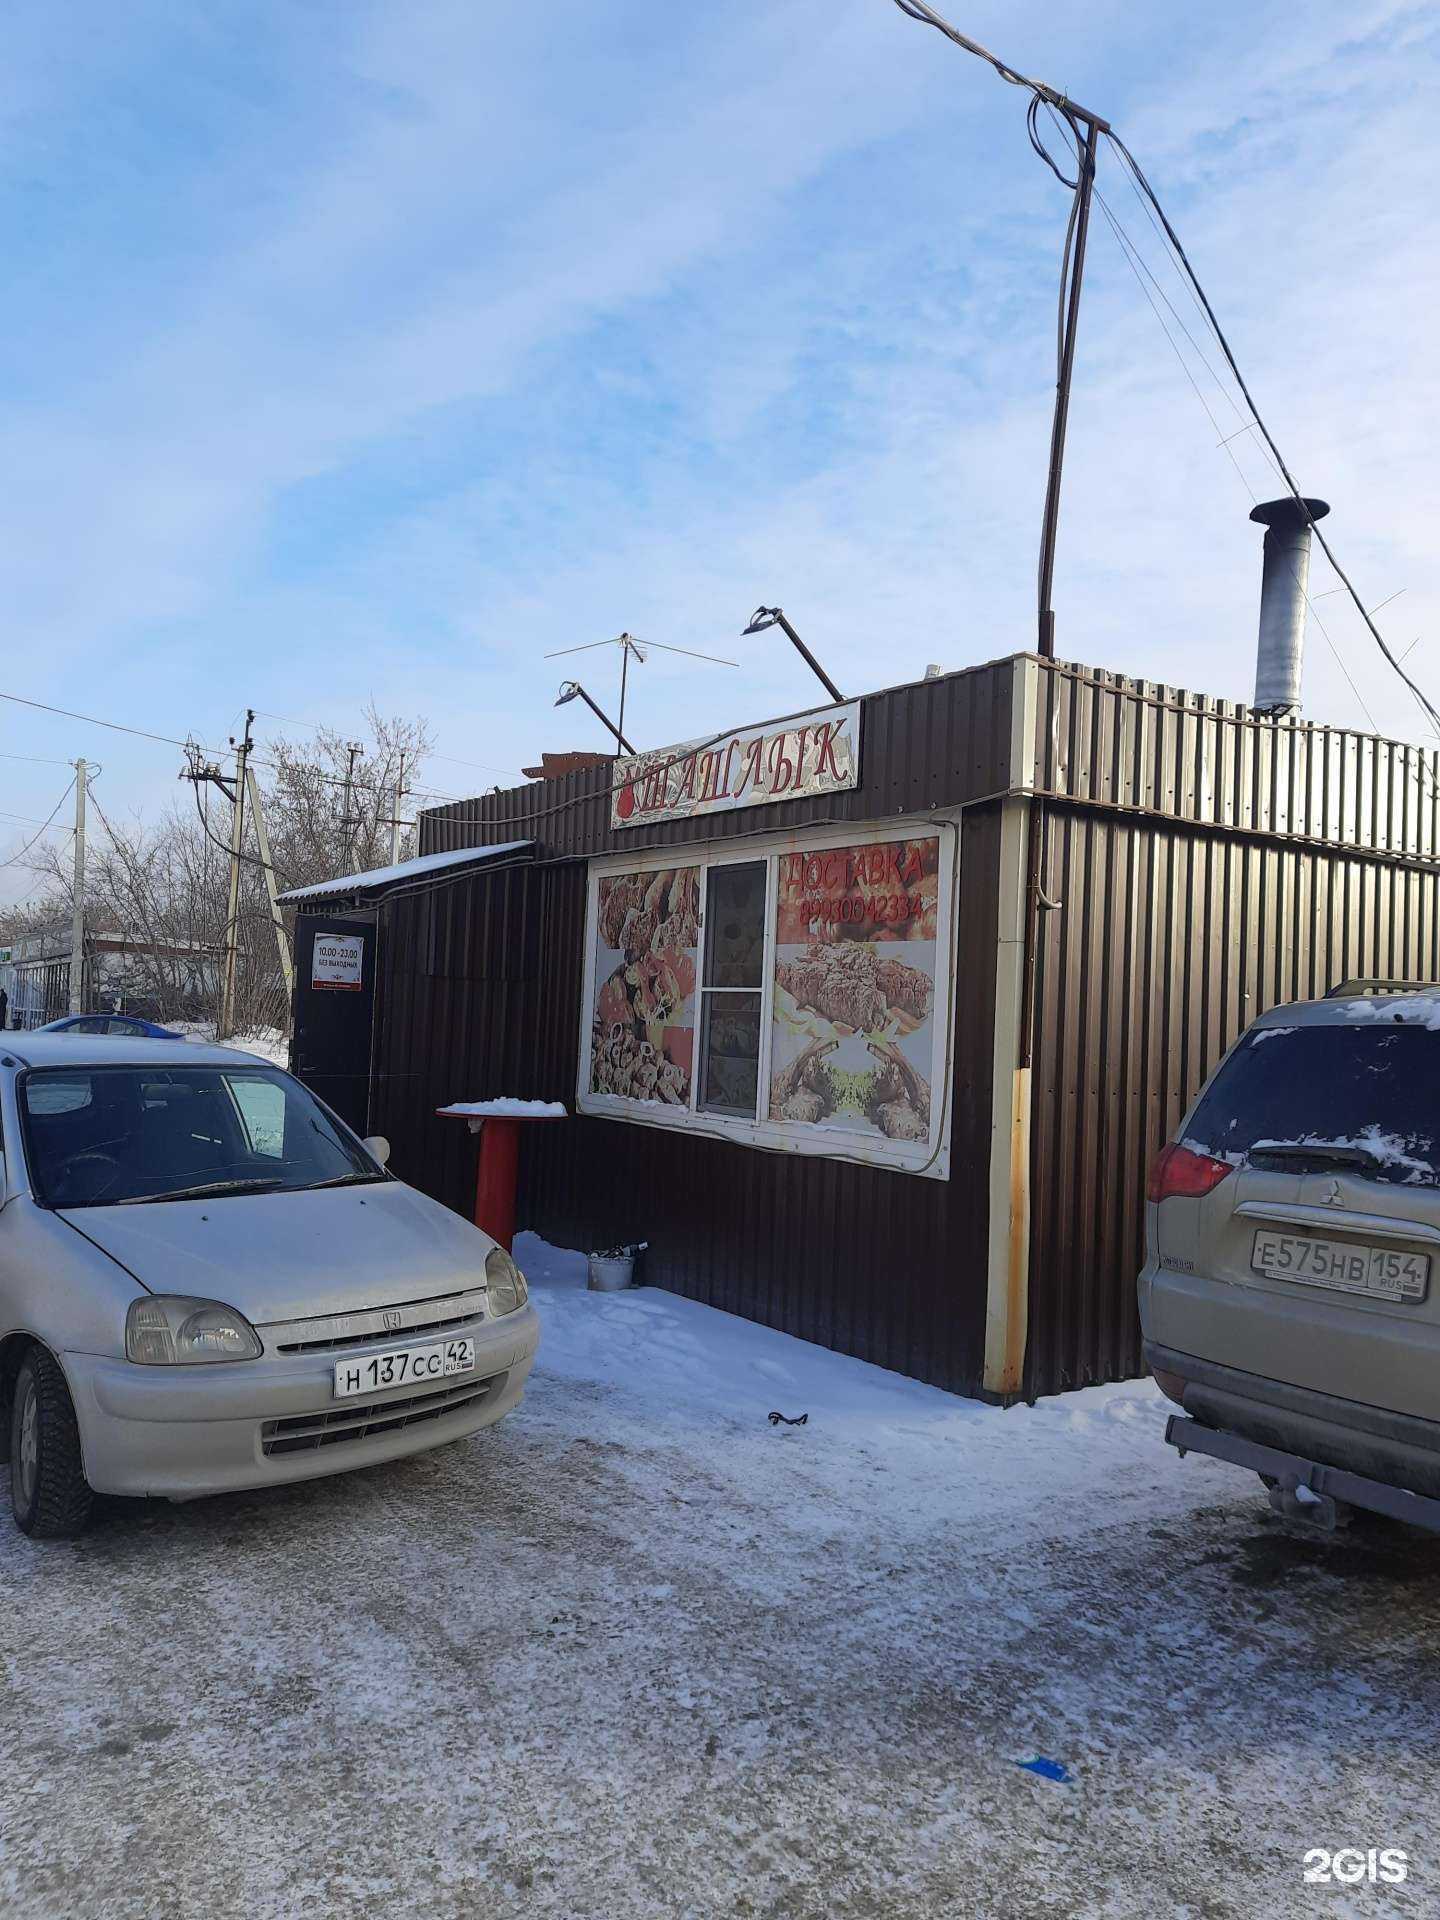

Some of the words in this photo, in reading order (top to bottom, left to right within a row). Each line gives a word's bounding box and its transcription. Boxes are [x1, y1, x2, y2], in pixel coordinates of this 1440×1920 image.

[637, 718, 848, 812] ШАШЛЫК
[787, 846, 923, 890] ДОСТАВКА
[328, 960, 358, 968] ВЫХОДНЫХ
[1261, 1238, 1365, 1281] Е575НВ
[1373, 1252, 1417, 1282] 154
[1380, 1278, 1401, 1290] RUS
[448, 1341, 468, 1362] 42
[445, 1362, 461, 1371] RUS
